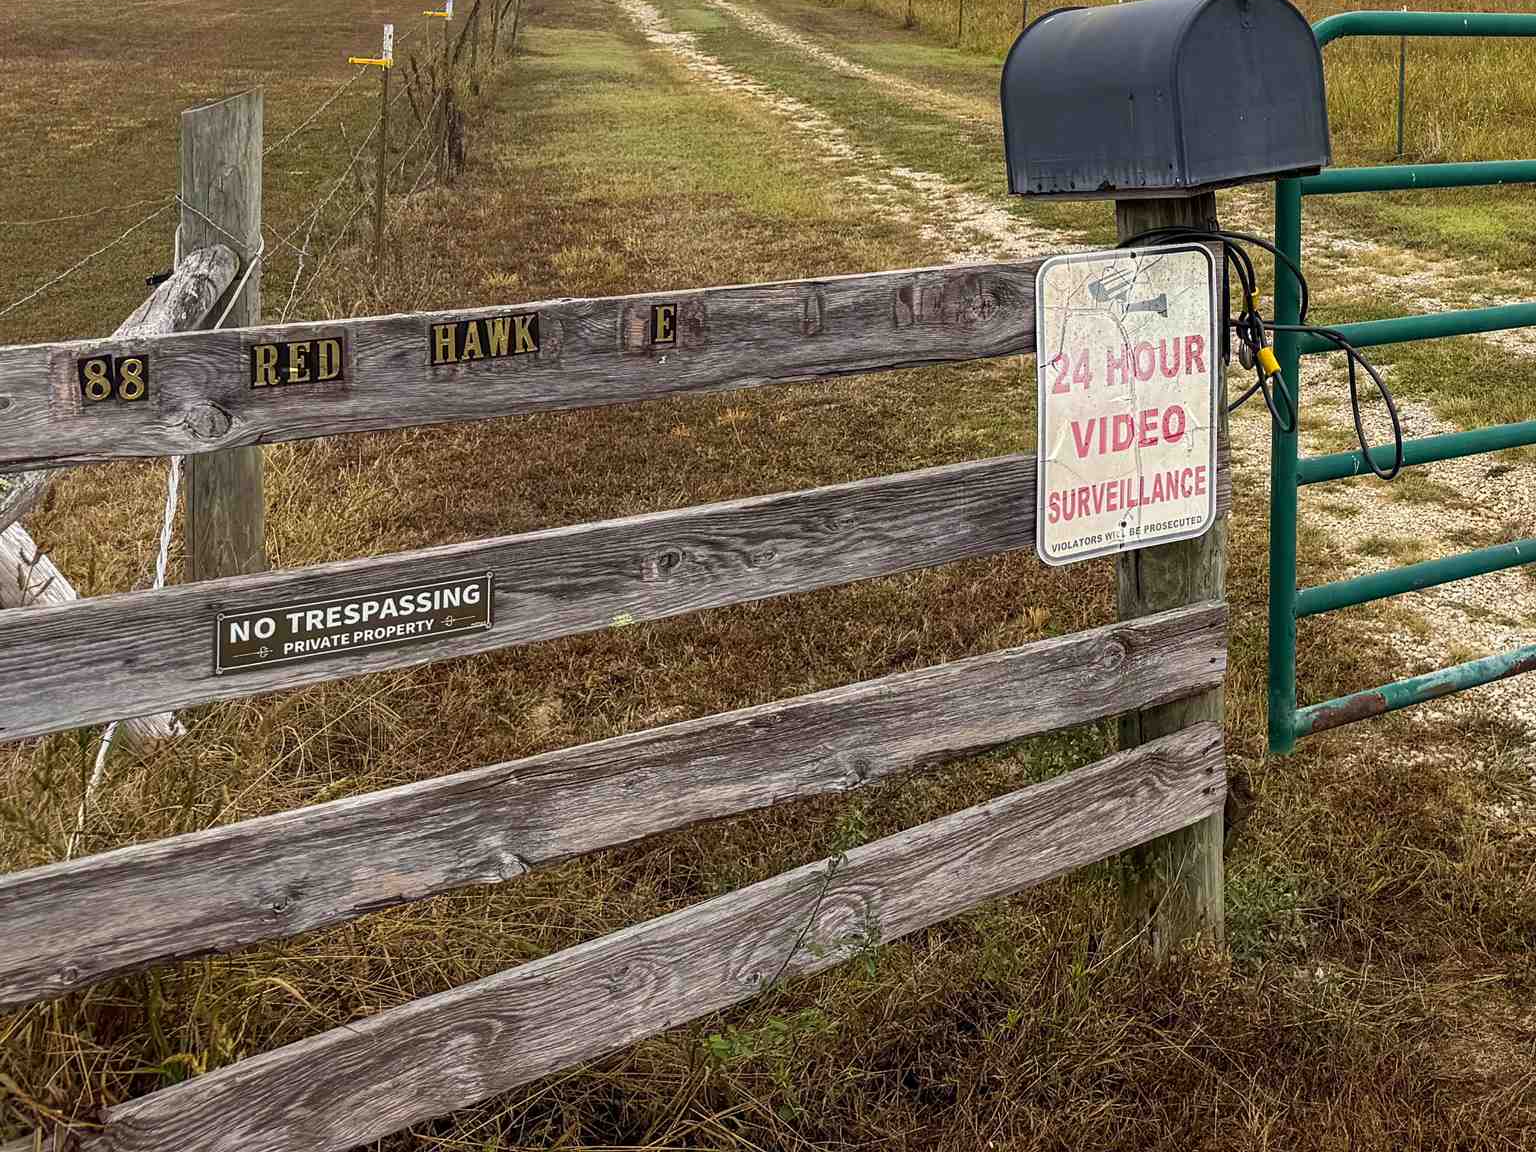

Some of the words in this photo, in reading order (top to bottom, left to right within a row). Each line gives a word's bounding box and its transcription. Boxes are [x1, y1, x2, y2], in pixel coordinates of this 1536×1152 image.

[83, 357, 146, 402] 88
[253, 339, 342, 389] RED
[433, 314, 538, 365] HAWK
[655, 304, 676, 342] E
[1051, 349, 1093, 395] 24
[1106, 334, 1207, 386] HOUR
[1071, 405, 1187, 459] VIDEO
[1048, 465, 1207, 525] SURVEILLANCE
[1051, 534, 1103, 553] VIOLATORS
[1129, 526, 1141, 537] BE
[1143, 515, 1203, 534] PROSECUTED
[229, 617, 277, 644] NO
[286, 583, 481, 634] TRESPASSING
[283, 632, 350, 655] PRIVATE
[353, 618, 435, 643] PROPERTY
